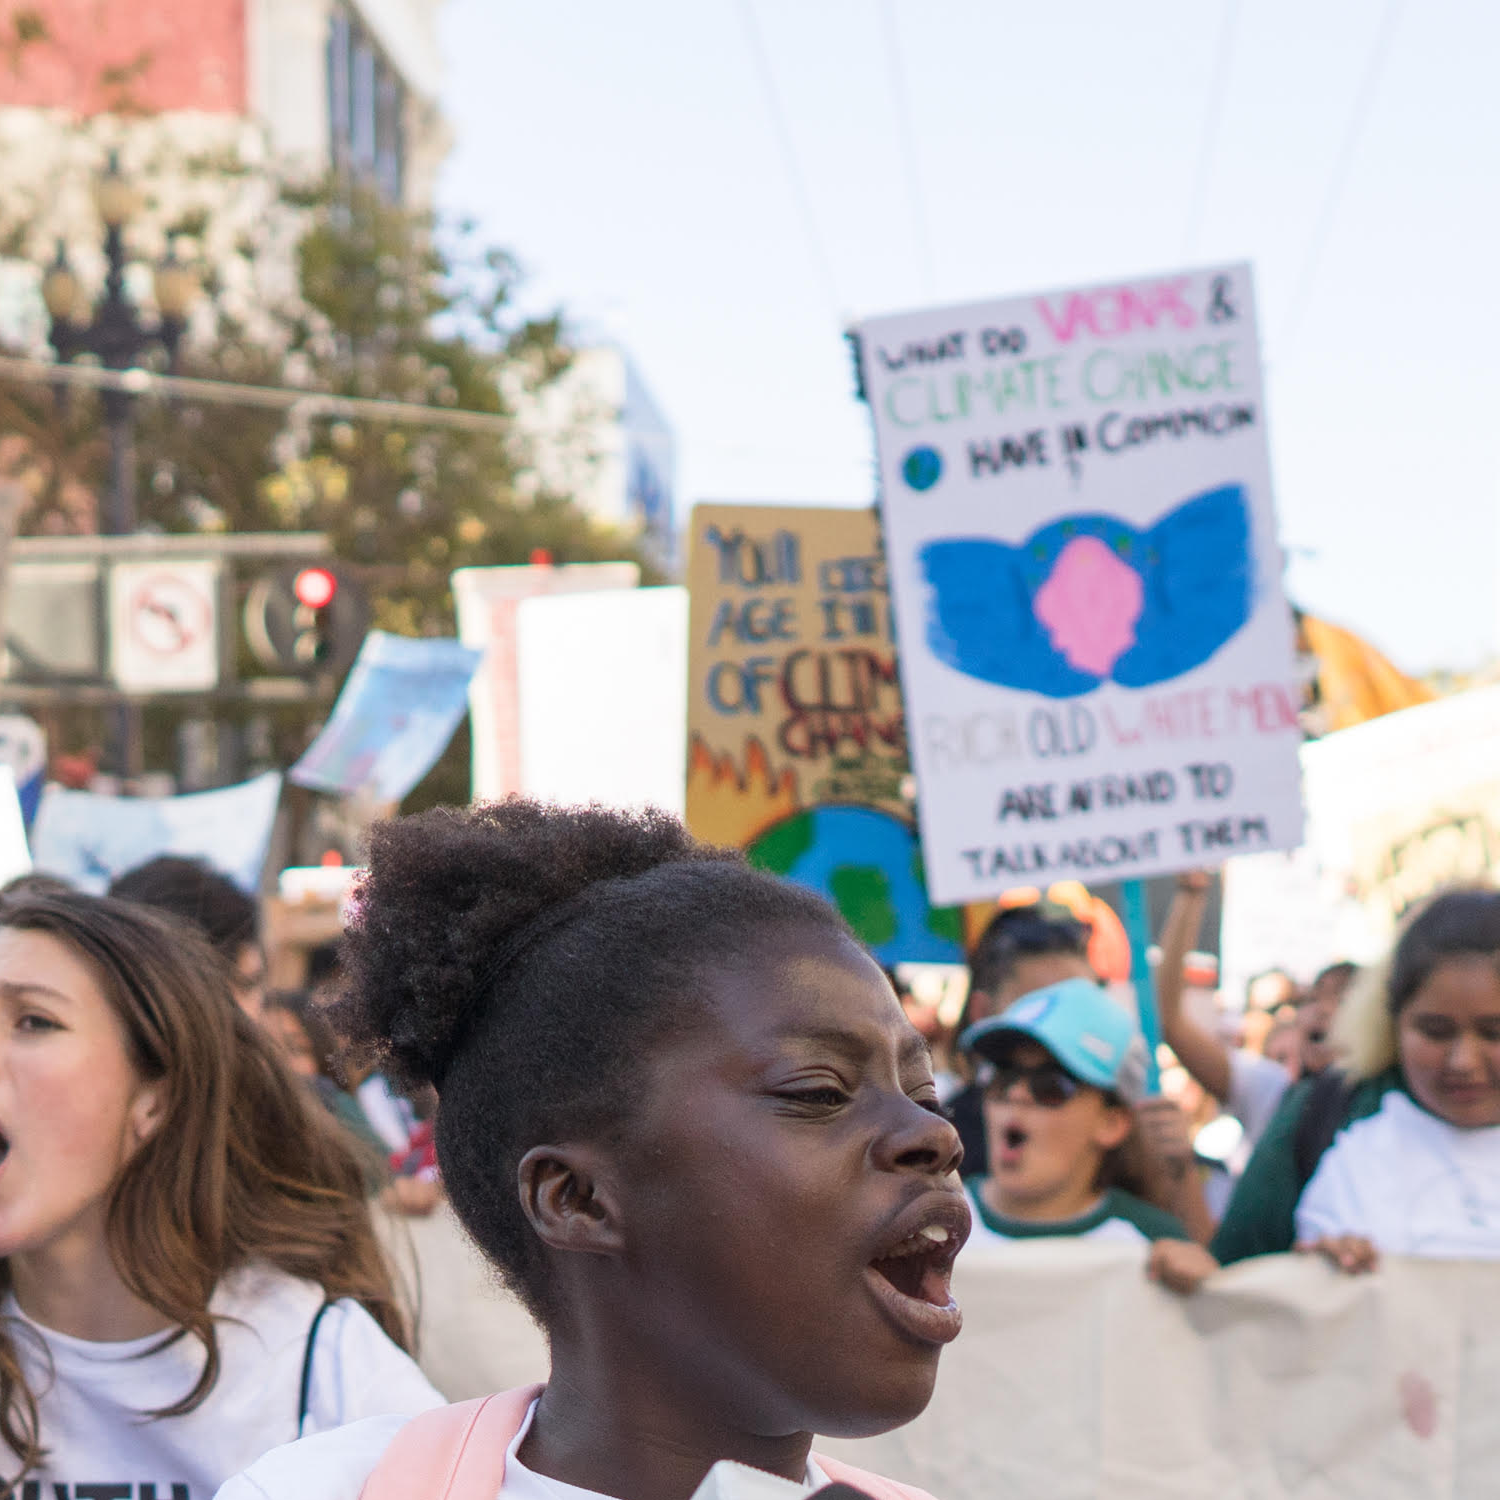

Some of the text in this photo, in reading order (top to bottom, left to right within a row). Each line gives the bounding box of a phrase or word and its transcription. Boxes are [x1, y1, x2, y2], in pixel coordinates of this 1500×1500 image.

[980, 327, 1028, 358] DO
[1208, 275, 1238, 324] &
[885, 340, 1241, 429] CLIMATE CHANGE
[968, 428, 1049, 479] HAVE
[1099, 403, 1255, 455] COMMON
[1028, 703, 1097, 758] OLD
[998, 783, 1057, 824] ARE
[1184, 762, 1234, 800] TO
[959, 815, 1271, 880] TALK ABOUT THEM
